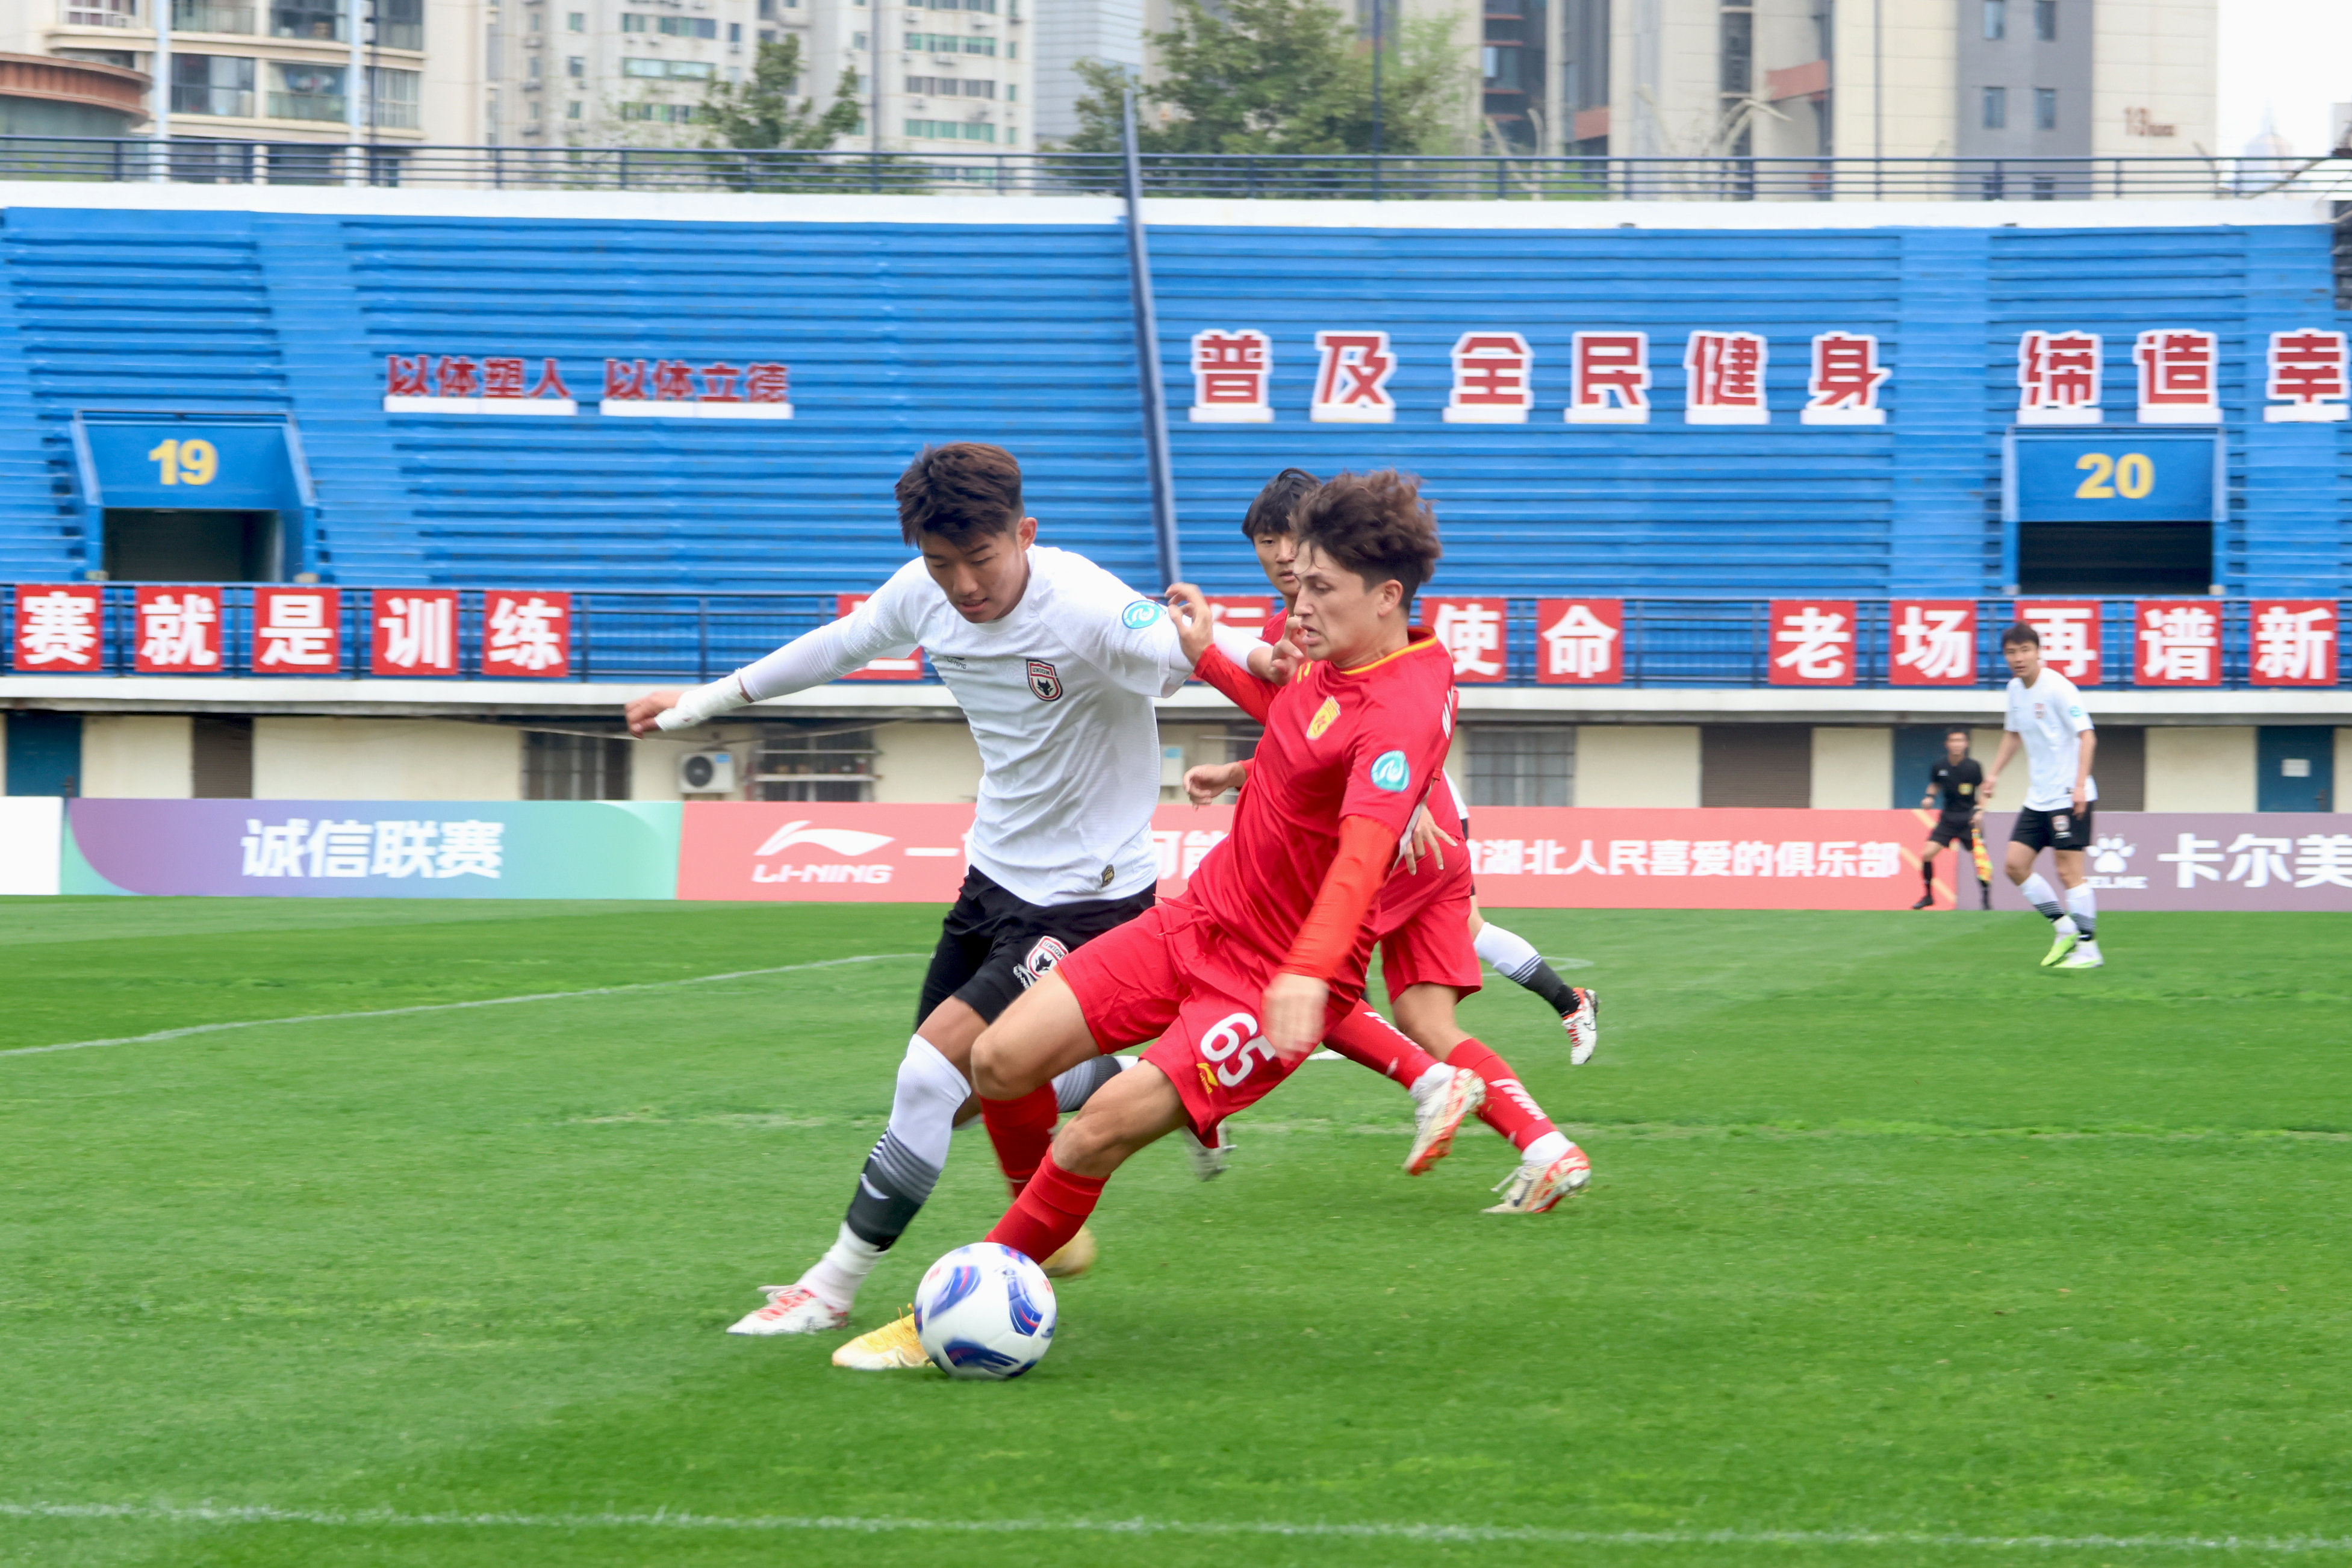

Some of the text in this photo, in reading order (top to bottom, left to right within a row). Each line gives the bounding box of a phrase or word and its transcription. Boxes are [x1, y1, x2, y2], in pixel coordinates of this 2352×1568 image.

[386, 355, 790, 403] 以体塑人 以体立德
[1192, 328, 2351, 412] 普及全民健身 缔造幸
[149, 438, 218, 486] 19
[2074, 453, 2154, 499] 20
[20, 590, 564, 671] 赛就是训练
[1775, 606, 2333, 680] 老场再谱新
[241, 818, 505, 879] 诚信联赛
[750, 864, 895, 885] LI-NING
[2156, 832, 2352, 889] 卡尔美
[1200, 1012, 1276, 1087] 65
